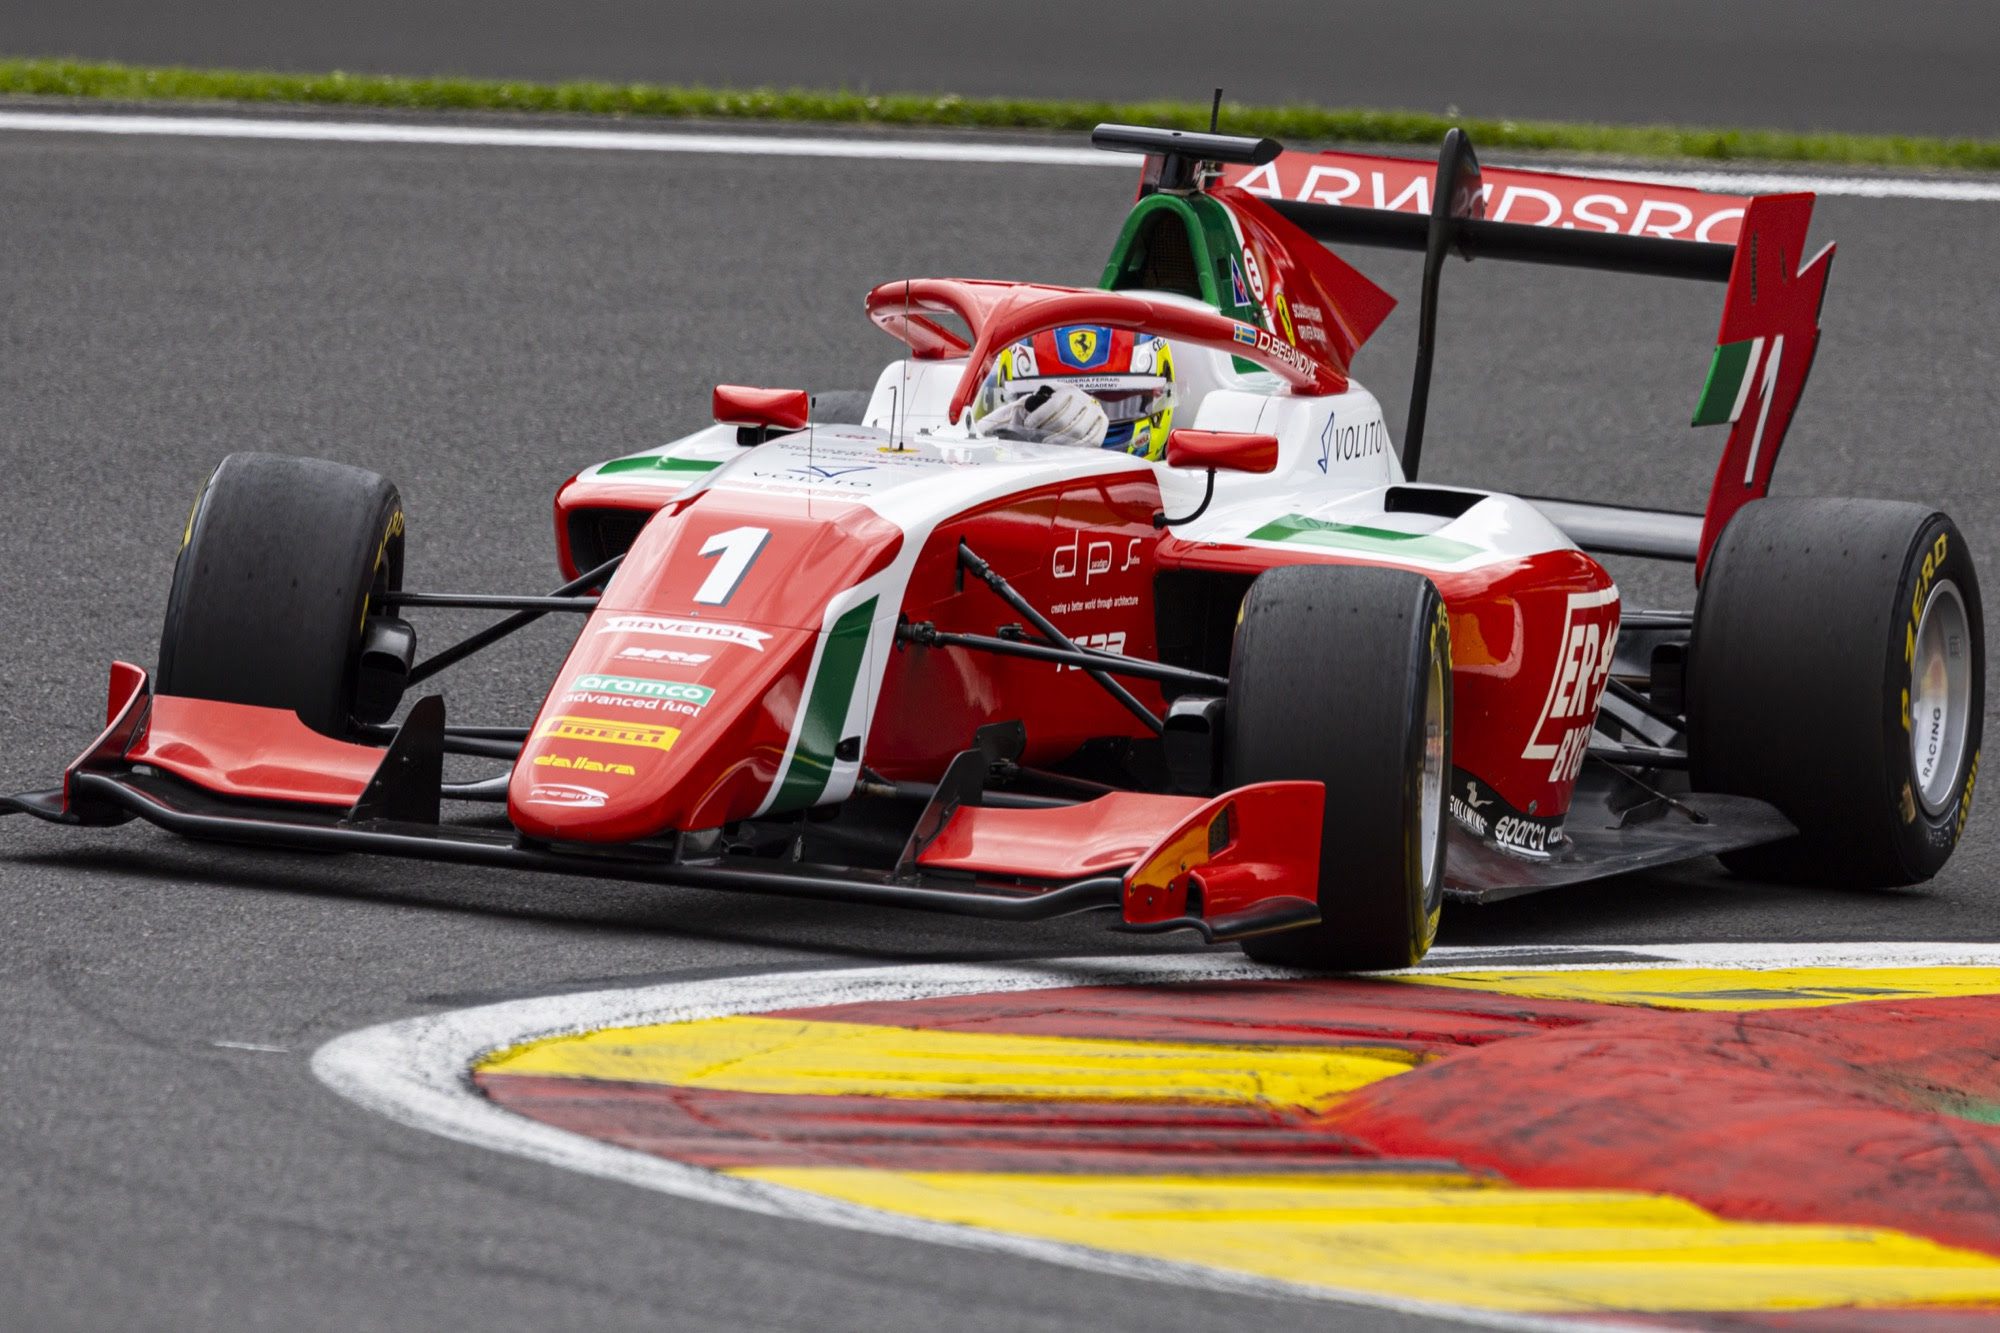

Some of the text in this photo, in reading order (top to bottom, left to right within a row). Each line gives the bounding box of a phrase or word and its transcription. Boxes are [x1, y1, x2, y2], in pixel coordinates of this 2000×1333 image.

[1745, 335, 1784, 488] 1
[1336, 419, 1382, 461] VOLITO
[692, 526, 772, 607] 1
[1905, 533, 1947, 673] ZERO
[617, 620, 751, 642] RAVENOL
[580, 675, 703, 699] aramco
[563, 691, 701, 718] advanced fuel
[549, 720, 666, 743] PIRELLI
[1922, 707, 1941, 778] RACING
[533, 754, 636, 776] dallara
